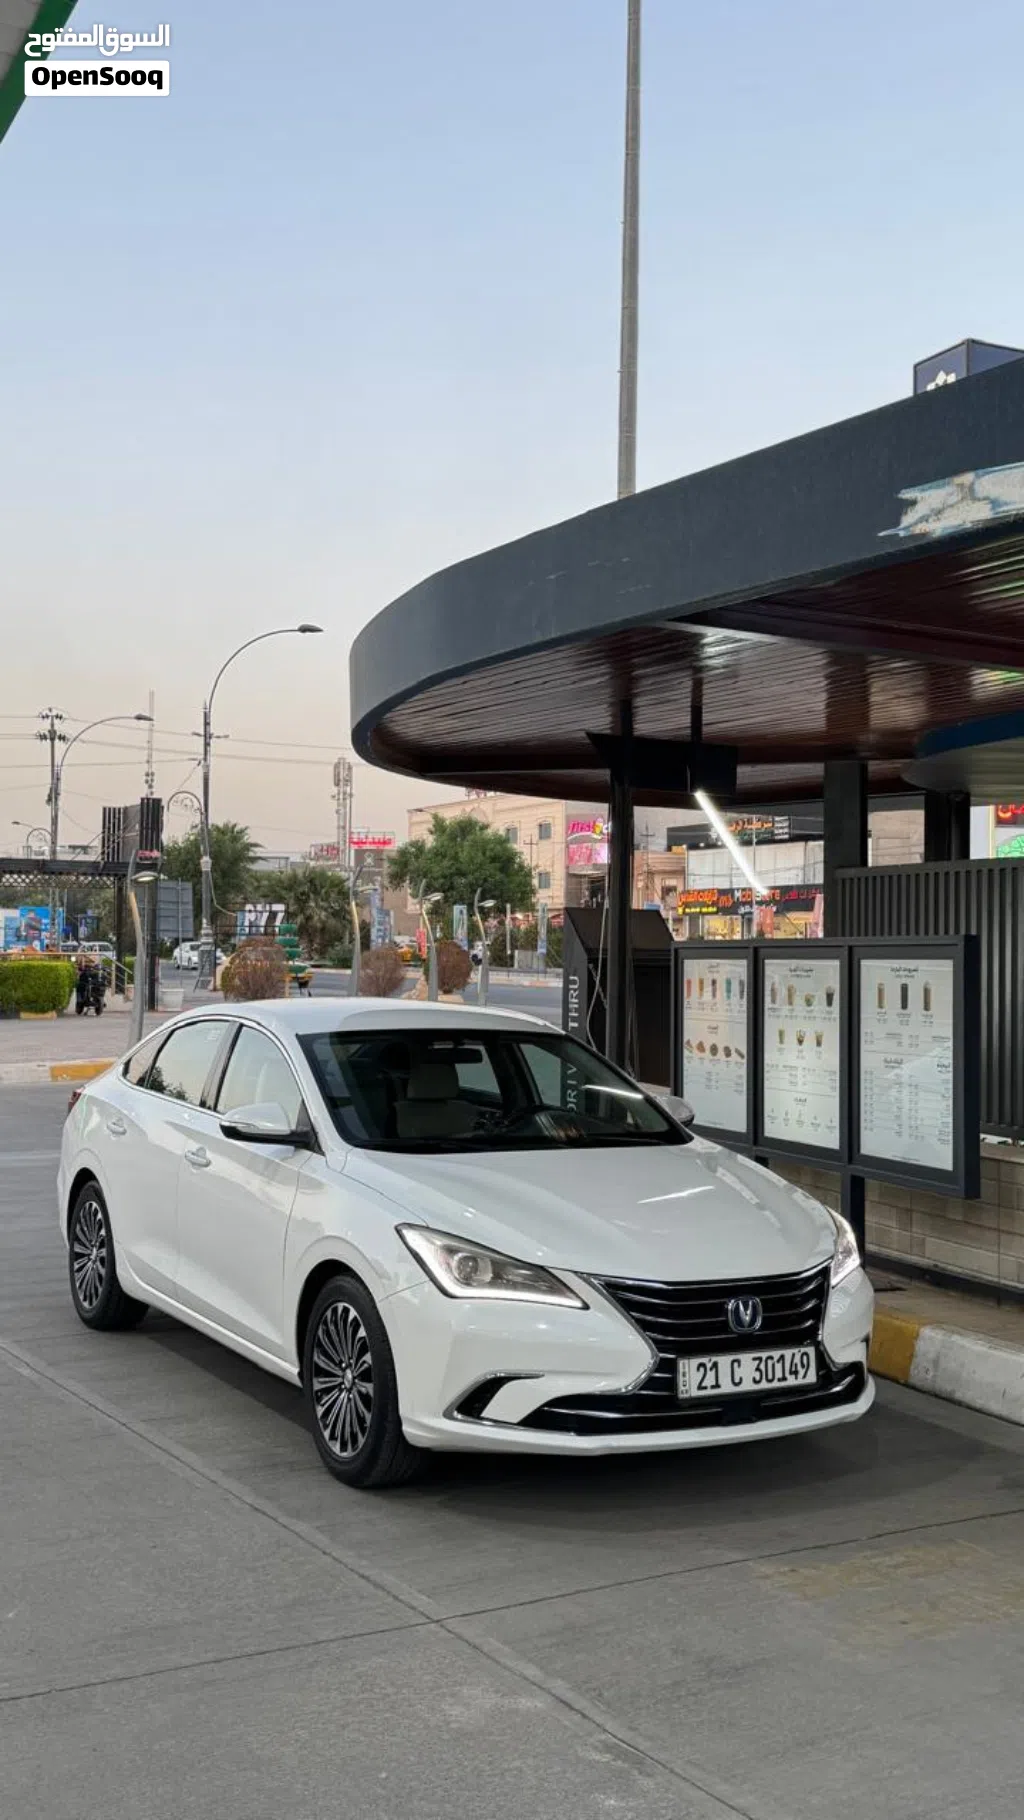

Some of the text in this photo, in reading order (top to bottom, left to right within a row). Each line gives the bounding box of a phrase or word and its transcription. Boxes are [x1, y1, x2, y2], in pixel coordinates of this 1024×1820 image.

[568, 975, 580, 1031] THRU
[697, 1351, 811, 1391] 21 C 30149
